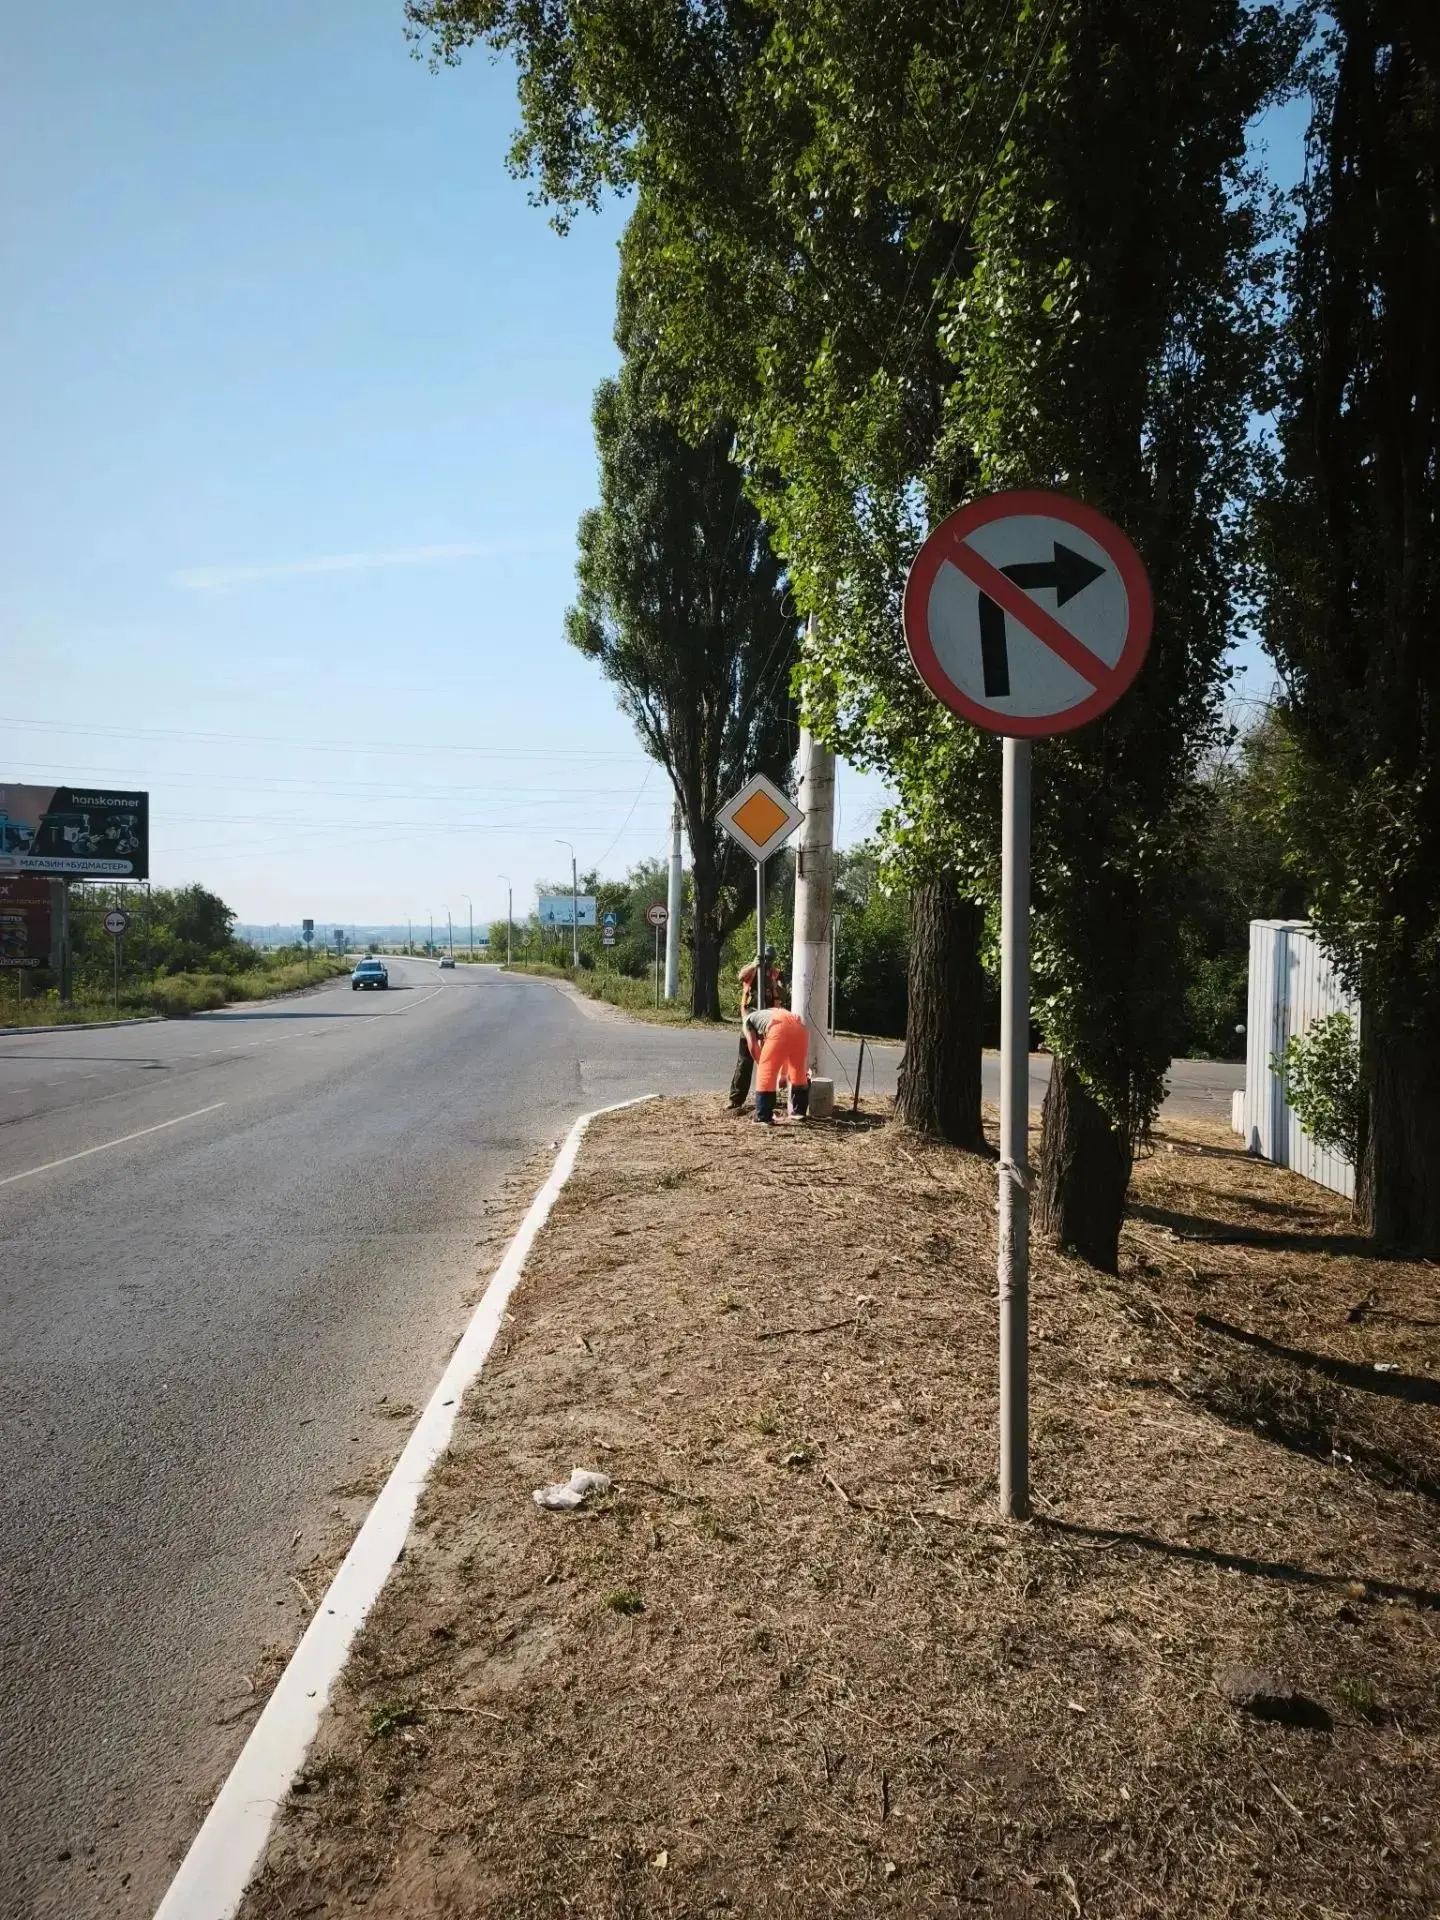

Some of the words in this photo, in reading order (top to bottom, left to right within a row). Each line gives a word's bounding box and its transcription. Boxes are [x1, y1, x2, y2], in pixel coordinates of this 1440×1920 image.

[72, 794, 140, 807] hanskonner
[20, 859, 64, 869] МАГАЗИН
[66, 861, 128, 870] «БУДМАСТЕР»
